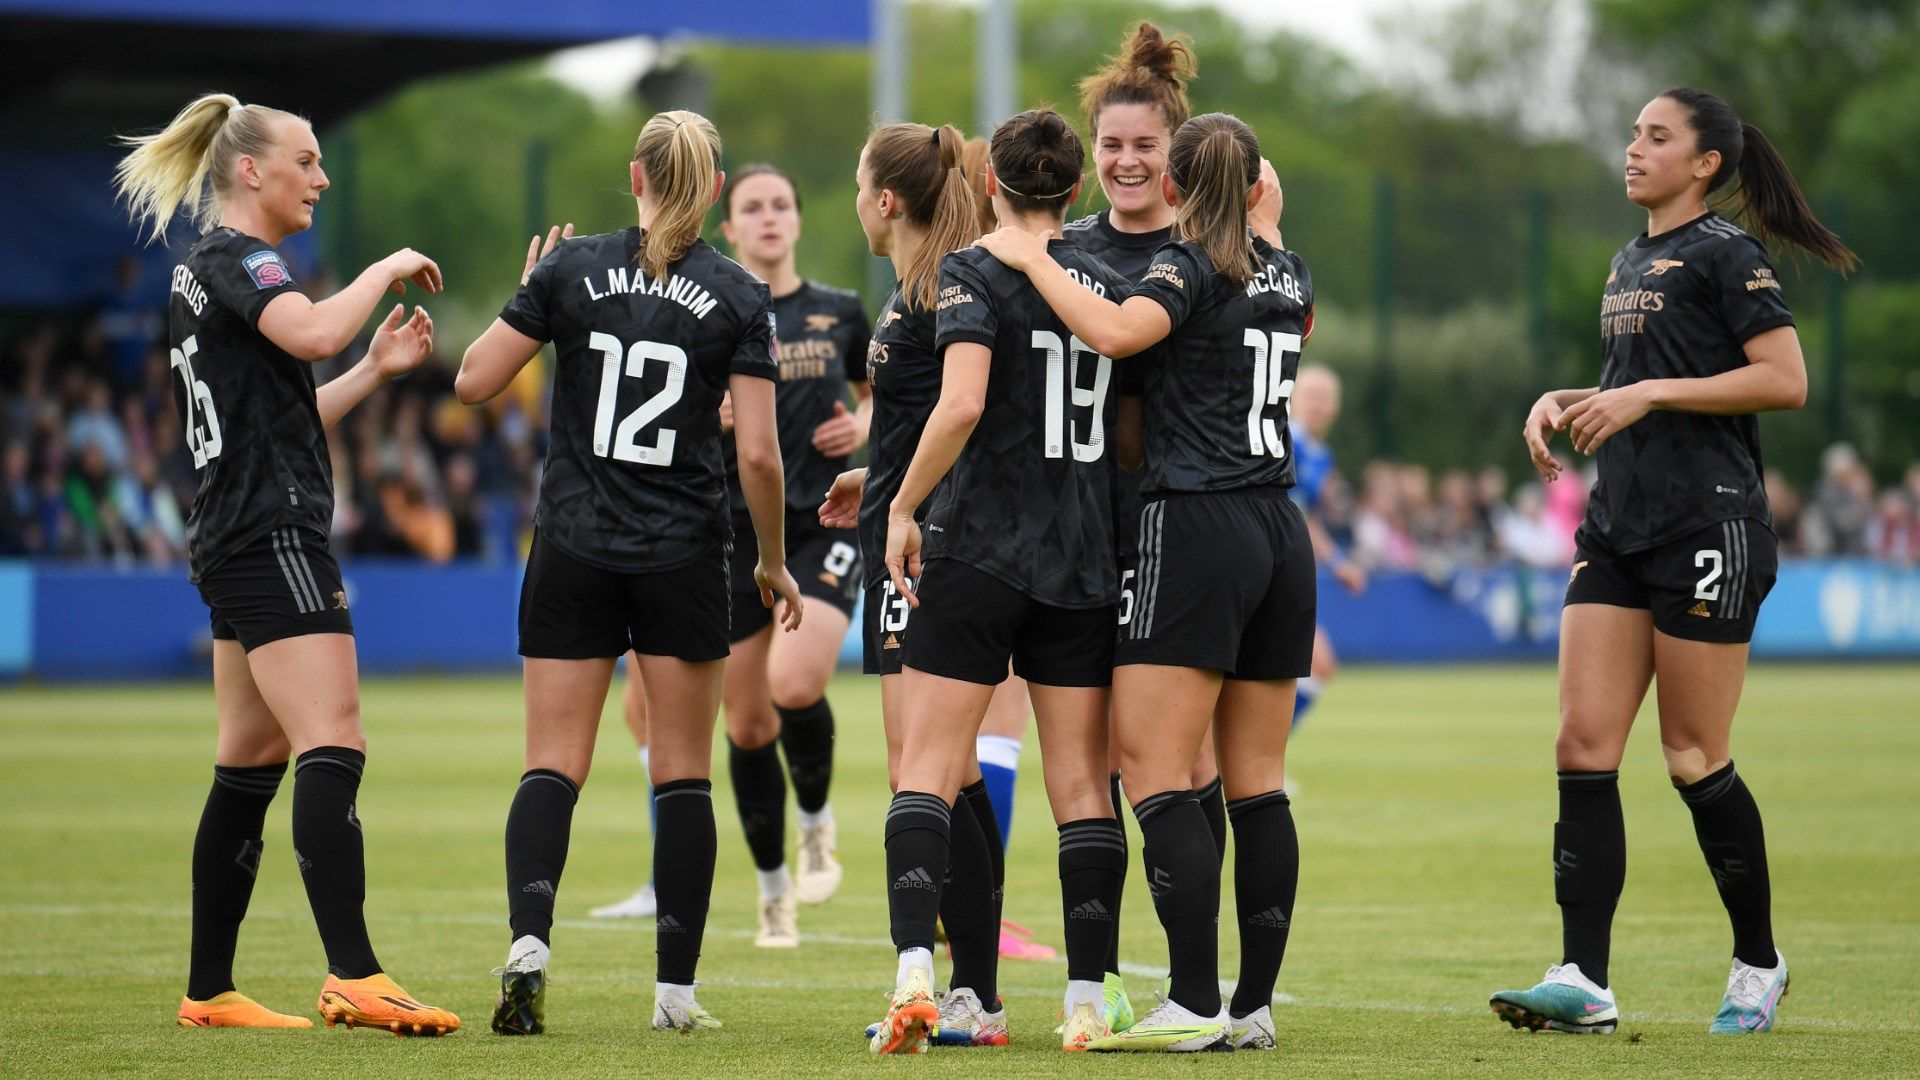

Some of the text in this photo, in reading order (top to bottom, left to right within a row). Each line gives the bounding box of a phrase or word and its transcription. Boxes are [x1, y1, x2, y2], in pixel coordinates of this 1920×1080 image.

[584, 267, 718, 320] L.MAANUM
[939, 284, 962, 299] VISIT
[1142, 270, 1184, 289] WANDA
[1152, 263, 1179, 274] VISIT
[936, 293, 974, 311] WANDA
[1614, 313, 1645, 336] BETTER
[170, 334, 222, 470] 25
[589, 331, 688, 467] 12
[1032, 330, 1112, 463] 19
[1243, 328, 1301, 459] 15
[1118, 570, 1135, 625] 5
[1694, 549, 1723, 601] 2
[880, 577, 912, 633] 13
[894, 879, 936, 893] adidas
